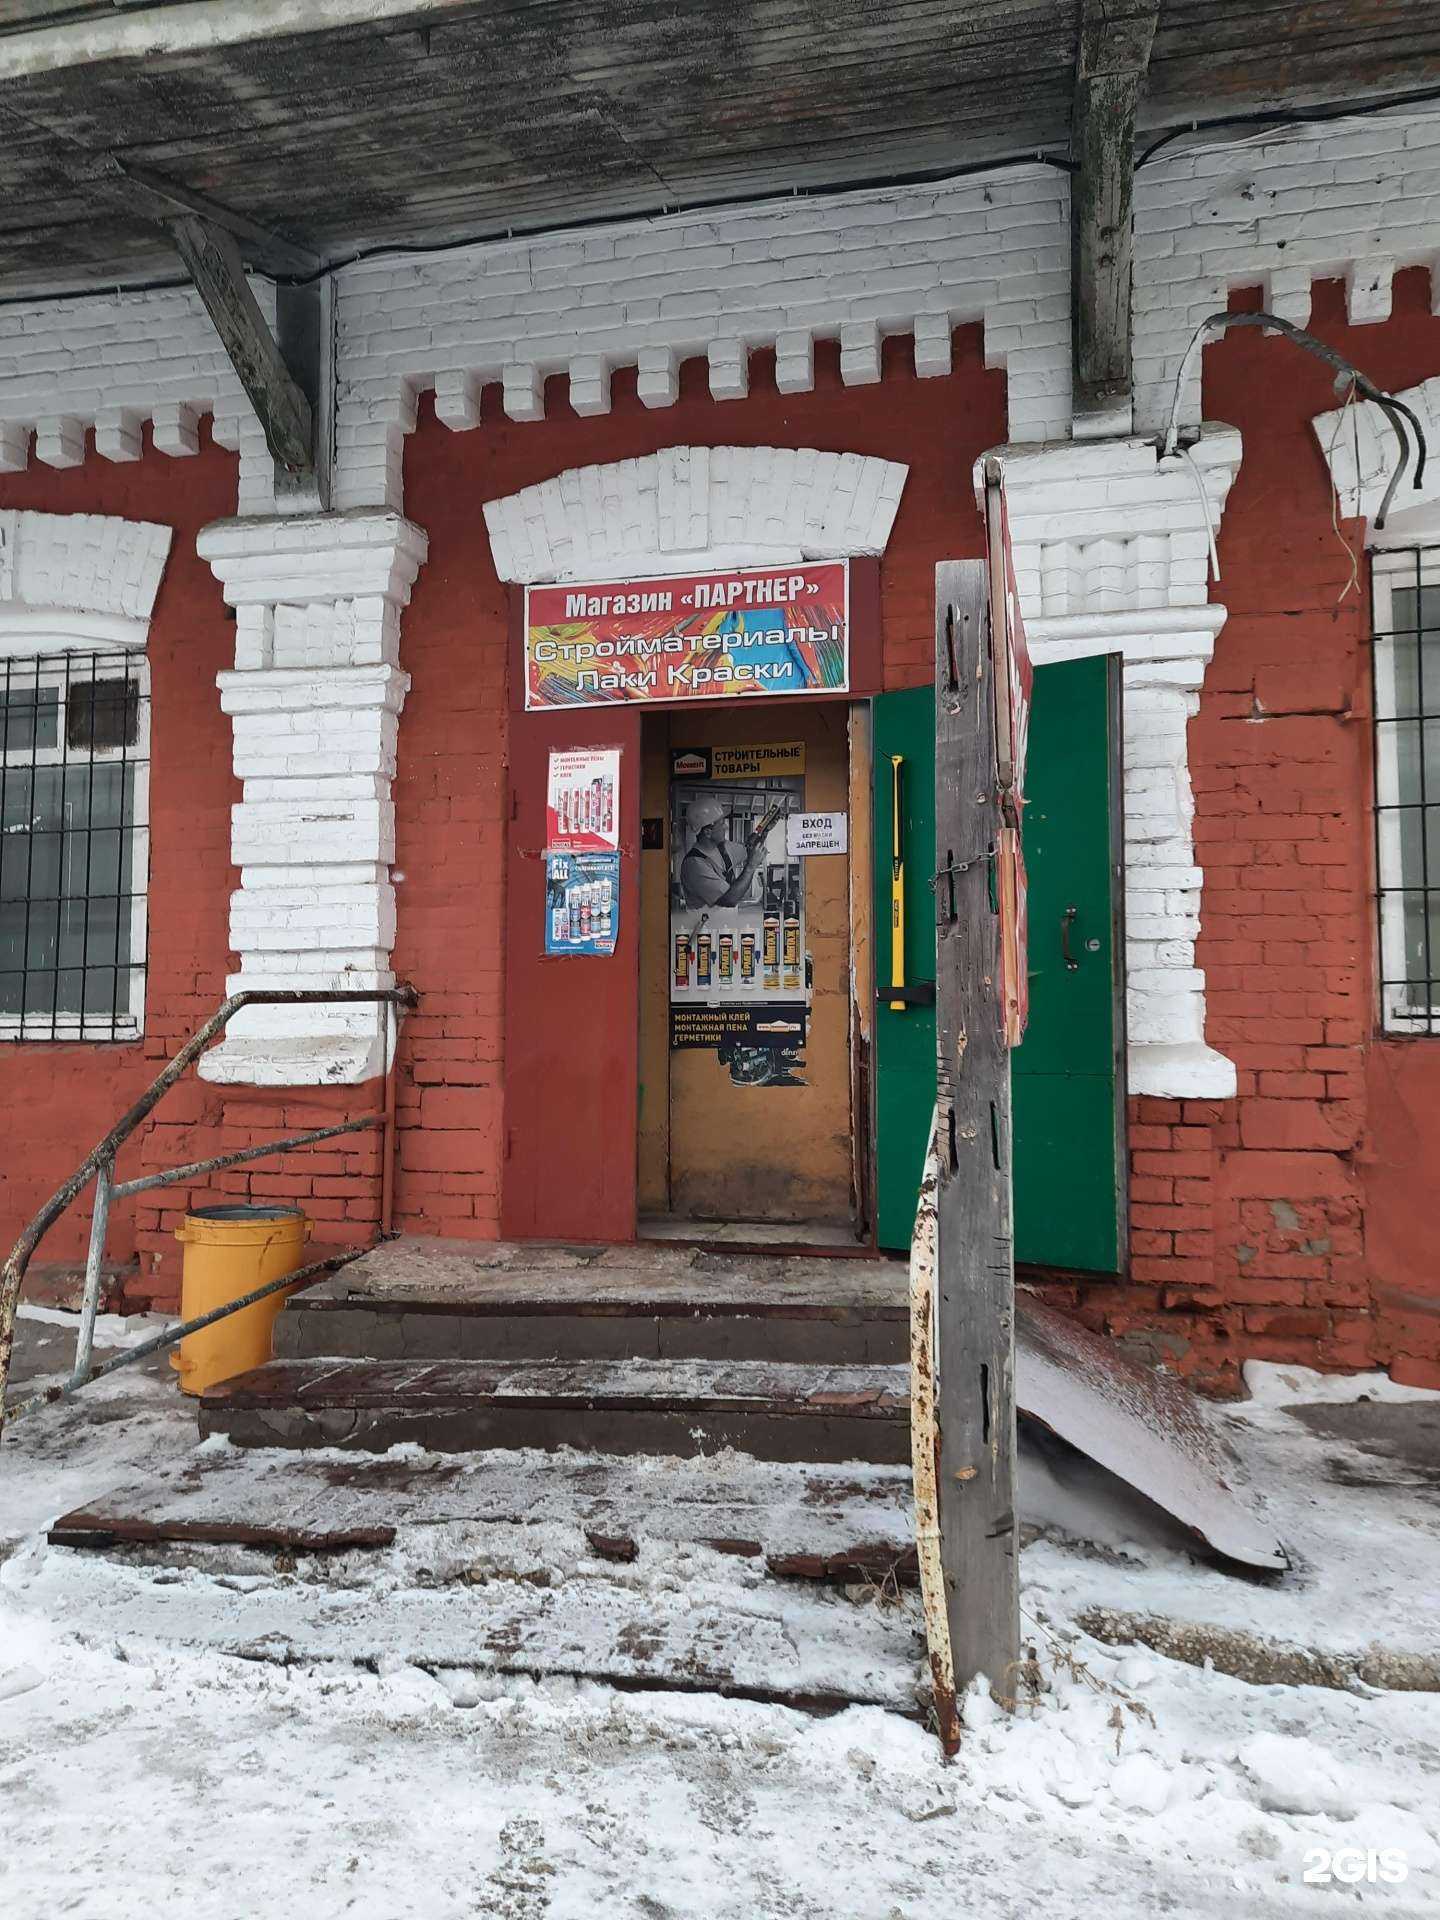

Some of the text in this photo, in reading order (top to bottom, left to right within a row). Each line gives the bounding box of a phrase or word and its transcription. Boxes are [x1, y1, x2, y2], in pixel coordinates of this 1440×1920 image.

[565, 575, 820, 617] Магазин «ПАРТНЕР»
[534, 625, 839, 663] Стройматериалы
[575, 659, 793, 692] Лаки Краски
[714, 746, 801, 761] СТРОИТЕЛЬНЫЕ
[714, 762, 760, 774] ТОВАРЫ
[802, 818, 832, 830] ВХОД
[795, 840, 840, 849] ЗАПРЕЩЕН
[552, 858, 569, 869] Fix
[552, 869, 569, 880] ALL
[674, 1012, 751, 1022] МОНТАЖНЫЙ КЛЕЙ
[674, 1023, 748, 1031] МОНТАЖНАЯ ПЕНА
[674, 1033, 722, 1042] ГЕРМЕТИКИ
